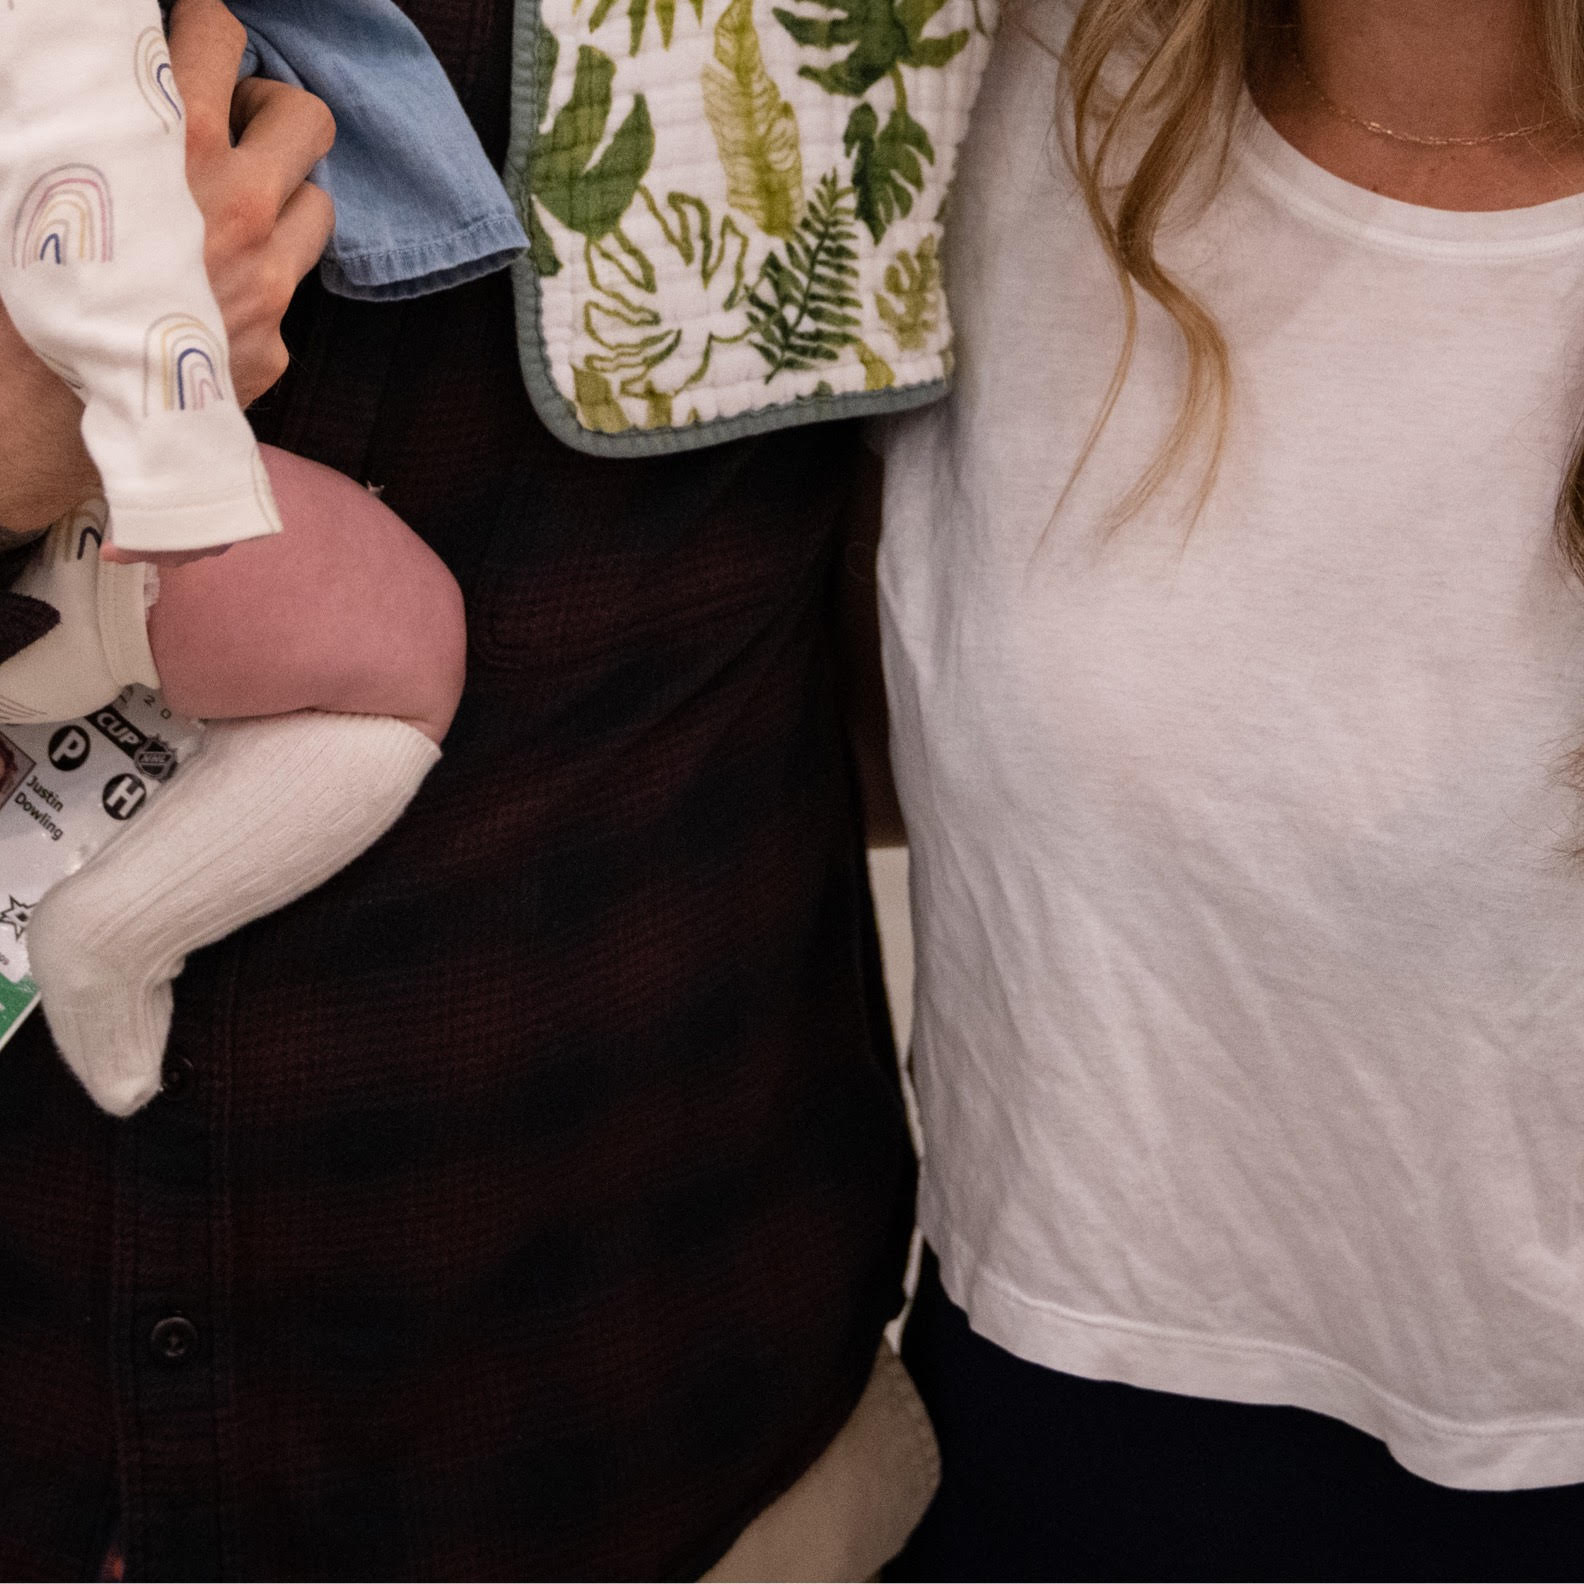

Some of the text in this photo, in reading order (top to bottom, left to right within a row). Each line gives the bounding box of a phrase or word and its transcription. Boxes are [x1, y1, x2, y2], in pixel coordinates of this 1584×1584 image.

[51, 724, 86, 762] P
[96, 711, 140, 745] CUP
[26, 775, 64, 812] Justin
[106, 776, 145, 818] H
[14, 791, 64, 842] Dowling
